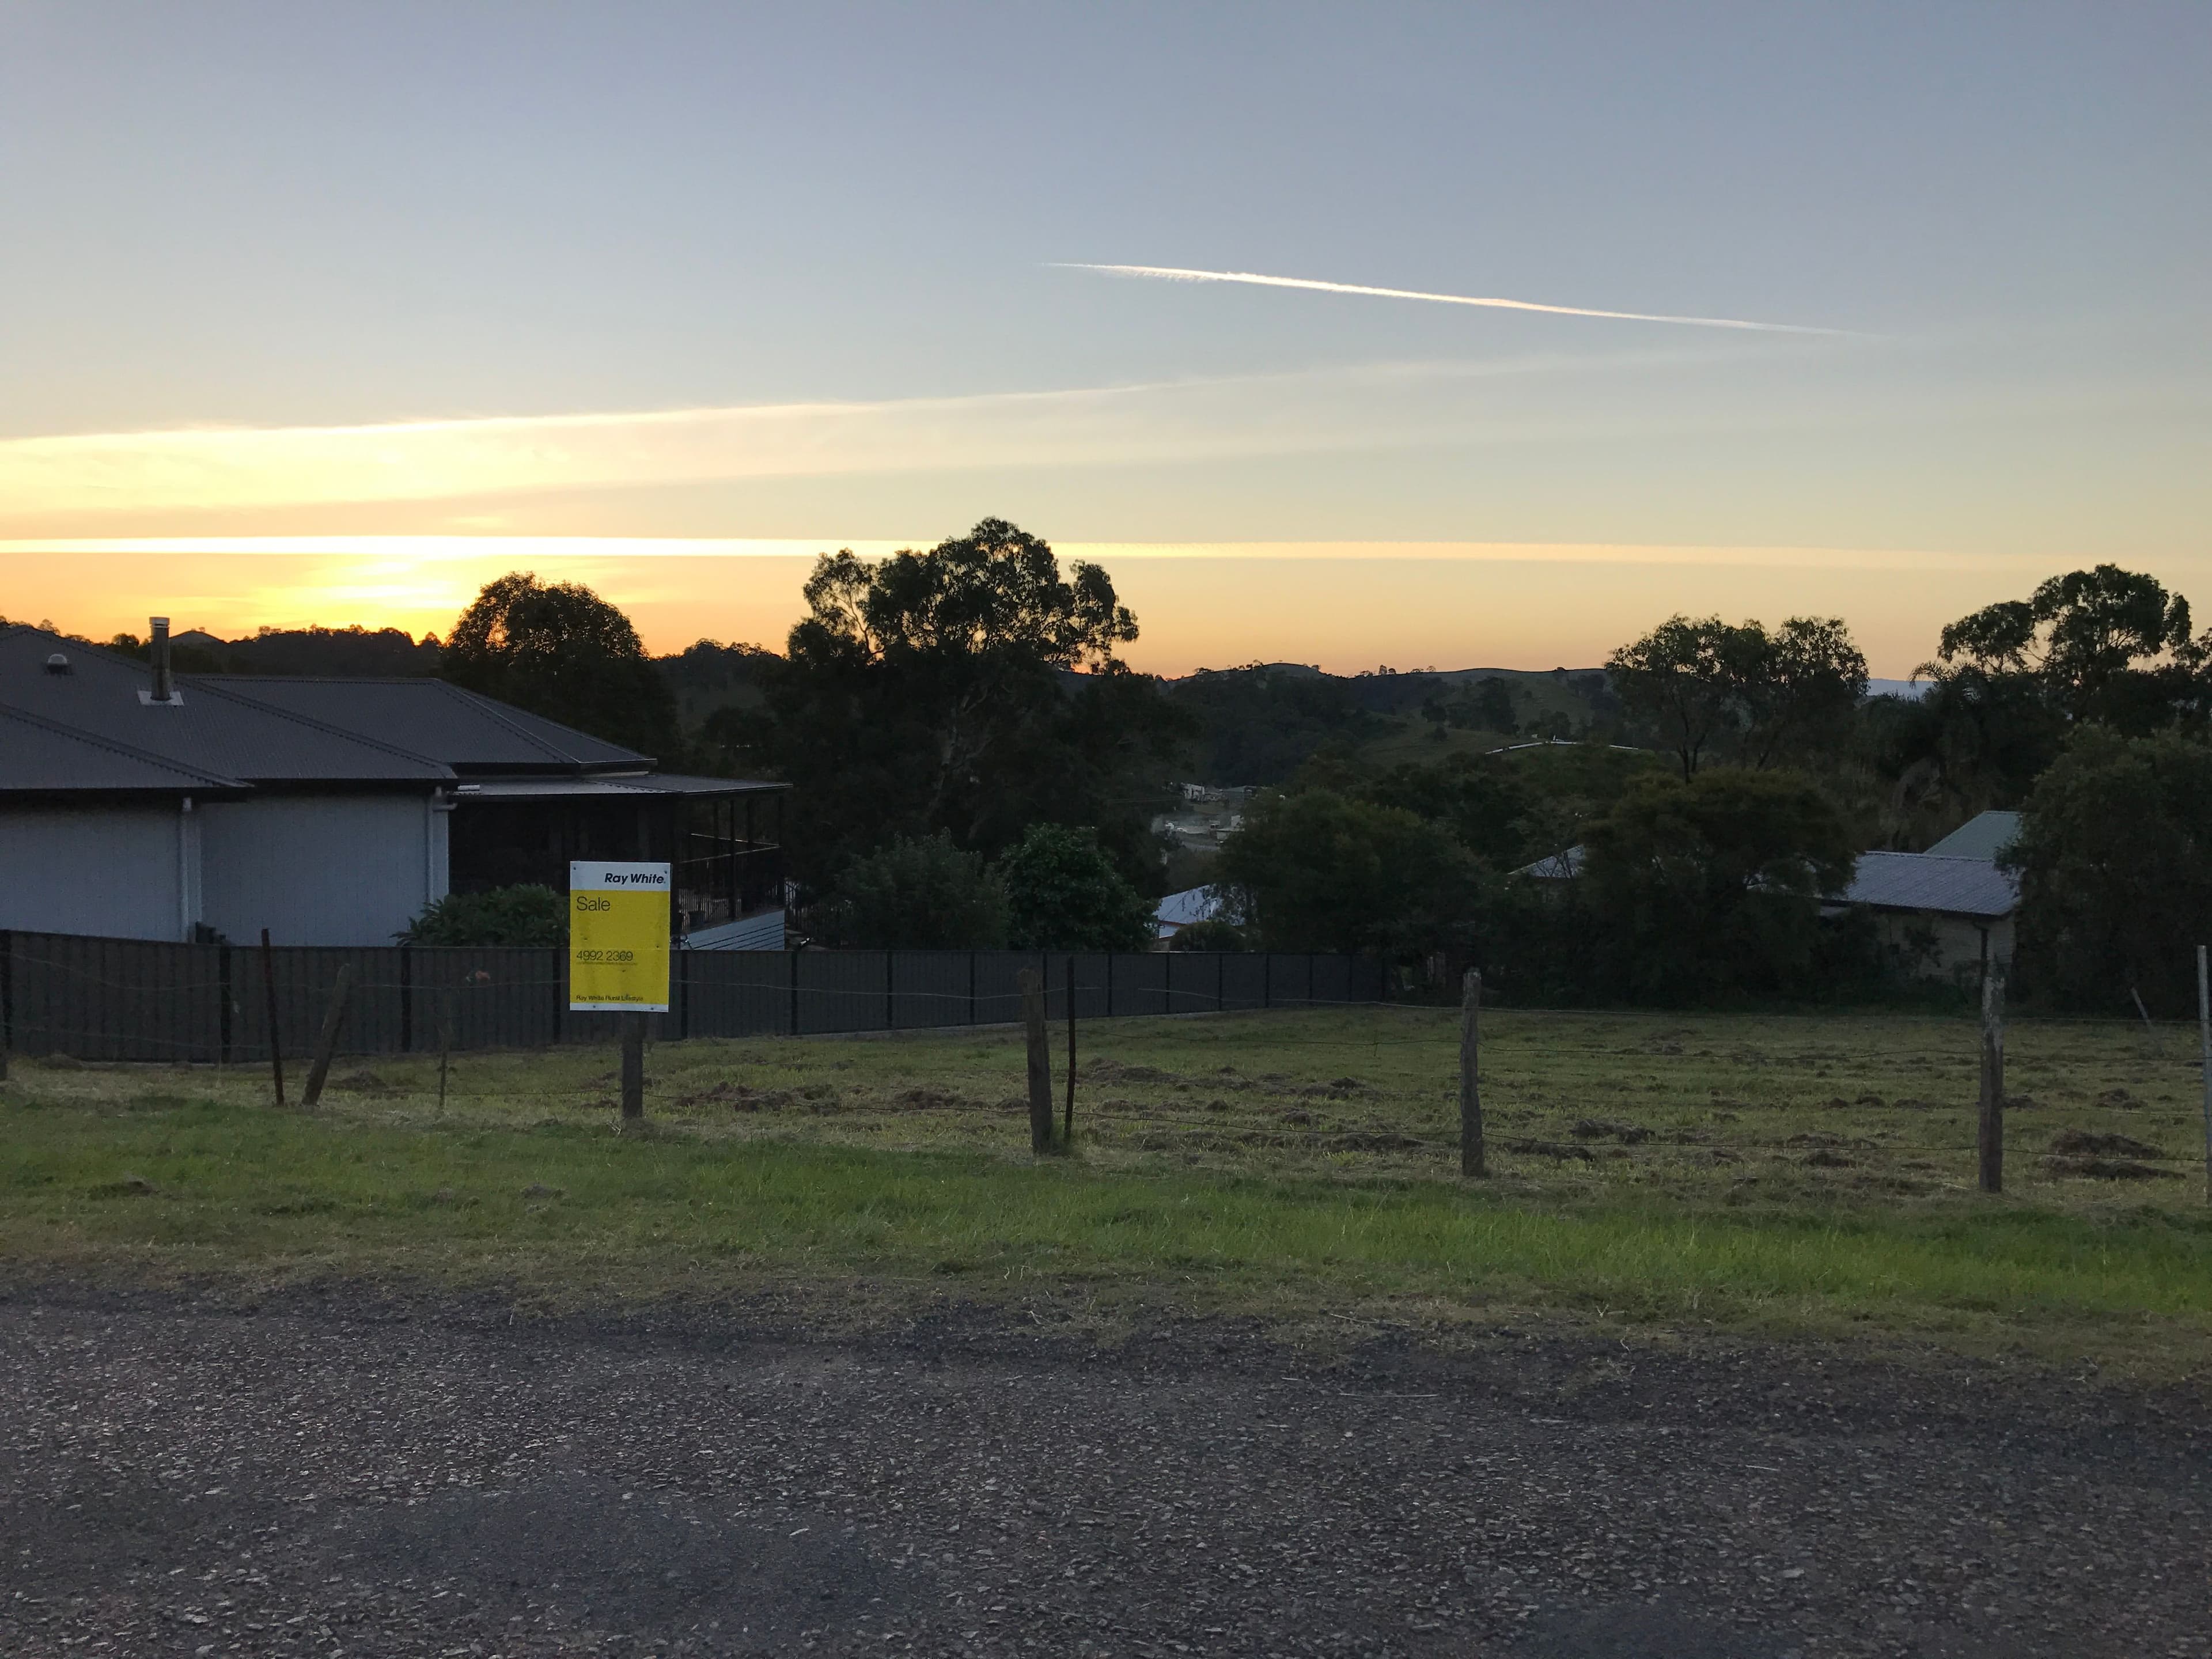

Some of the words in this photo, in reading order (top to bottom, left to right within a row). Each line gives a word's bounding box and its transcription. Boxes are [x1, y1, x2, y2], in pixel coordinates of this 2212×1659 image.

[605, 873, 628, 884] Ray
[577, 896, 611, 911] Sale
[577, 950, 603, 961] 4992
[606, 951, 634, 961] 2369
